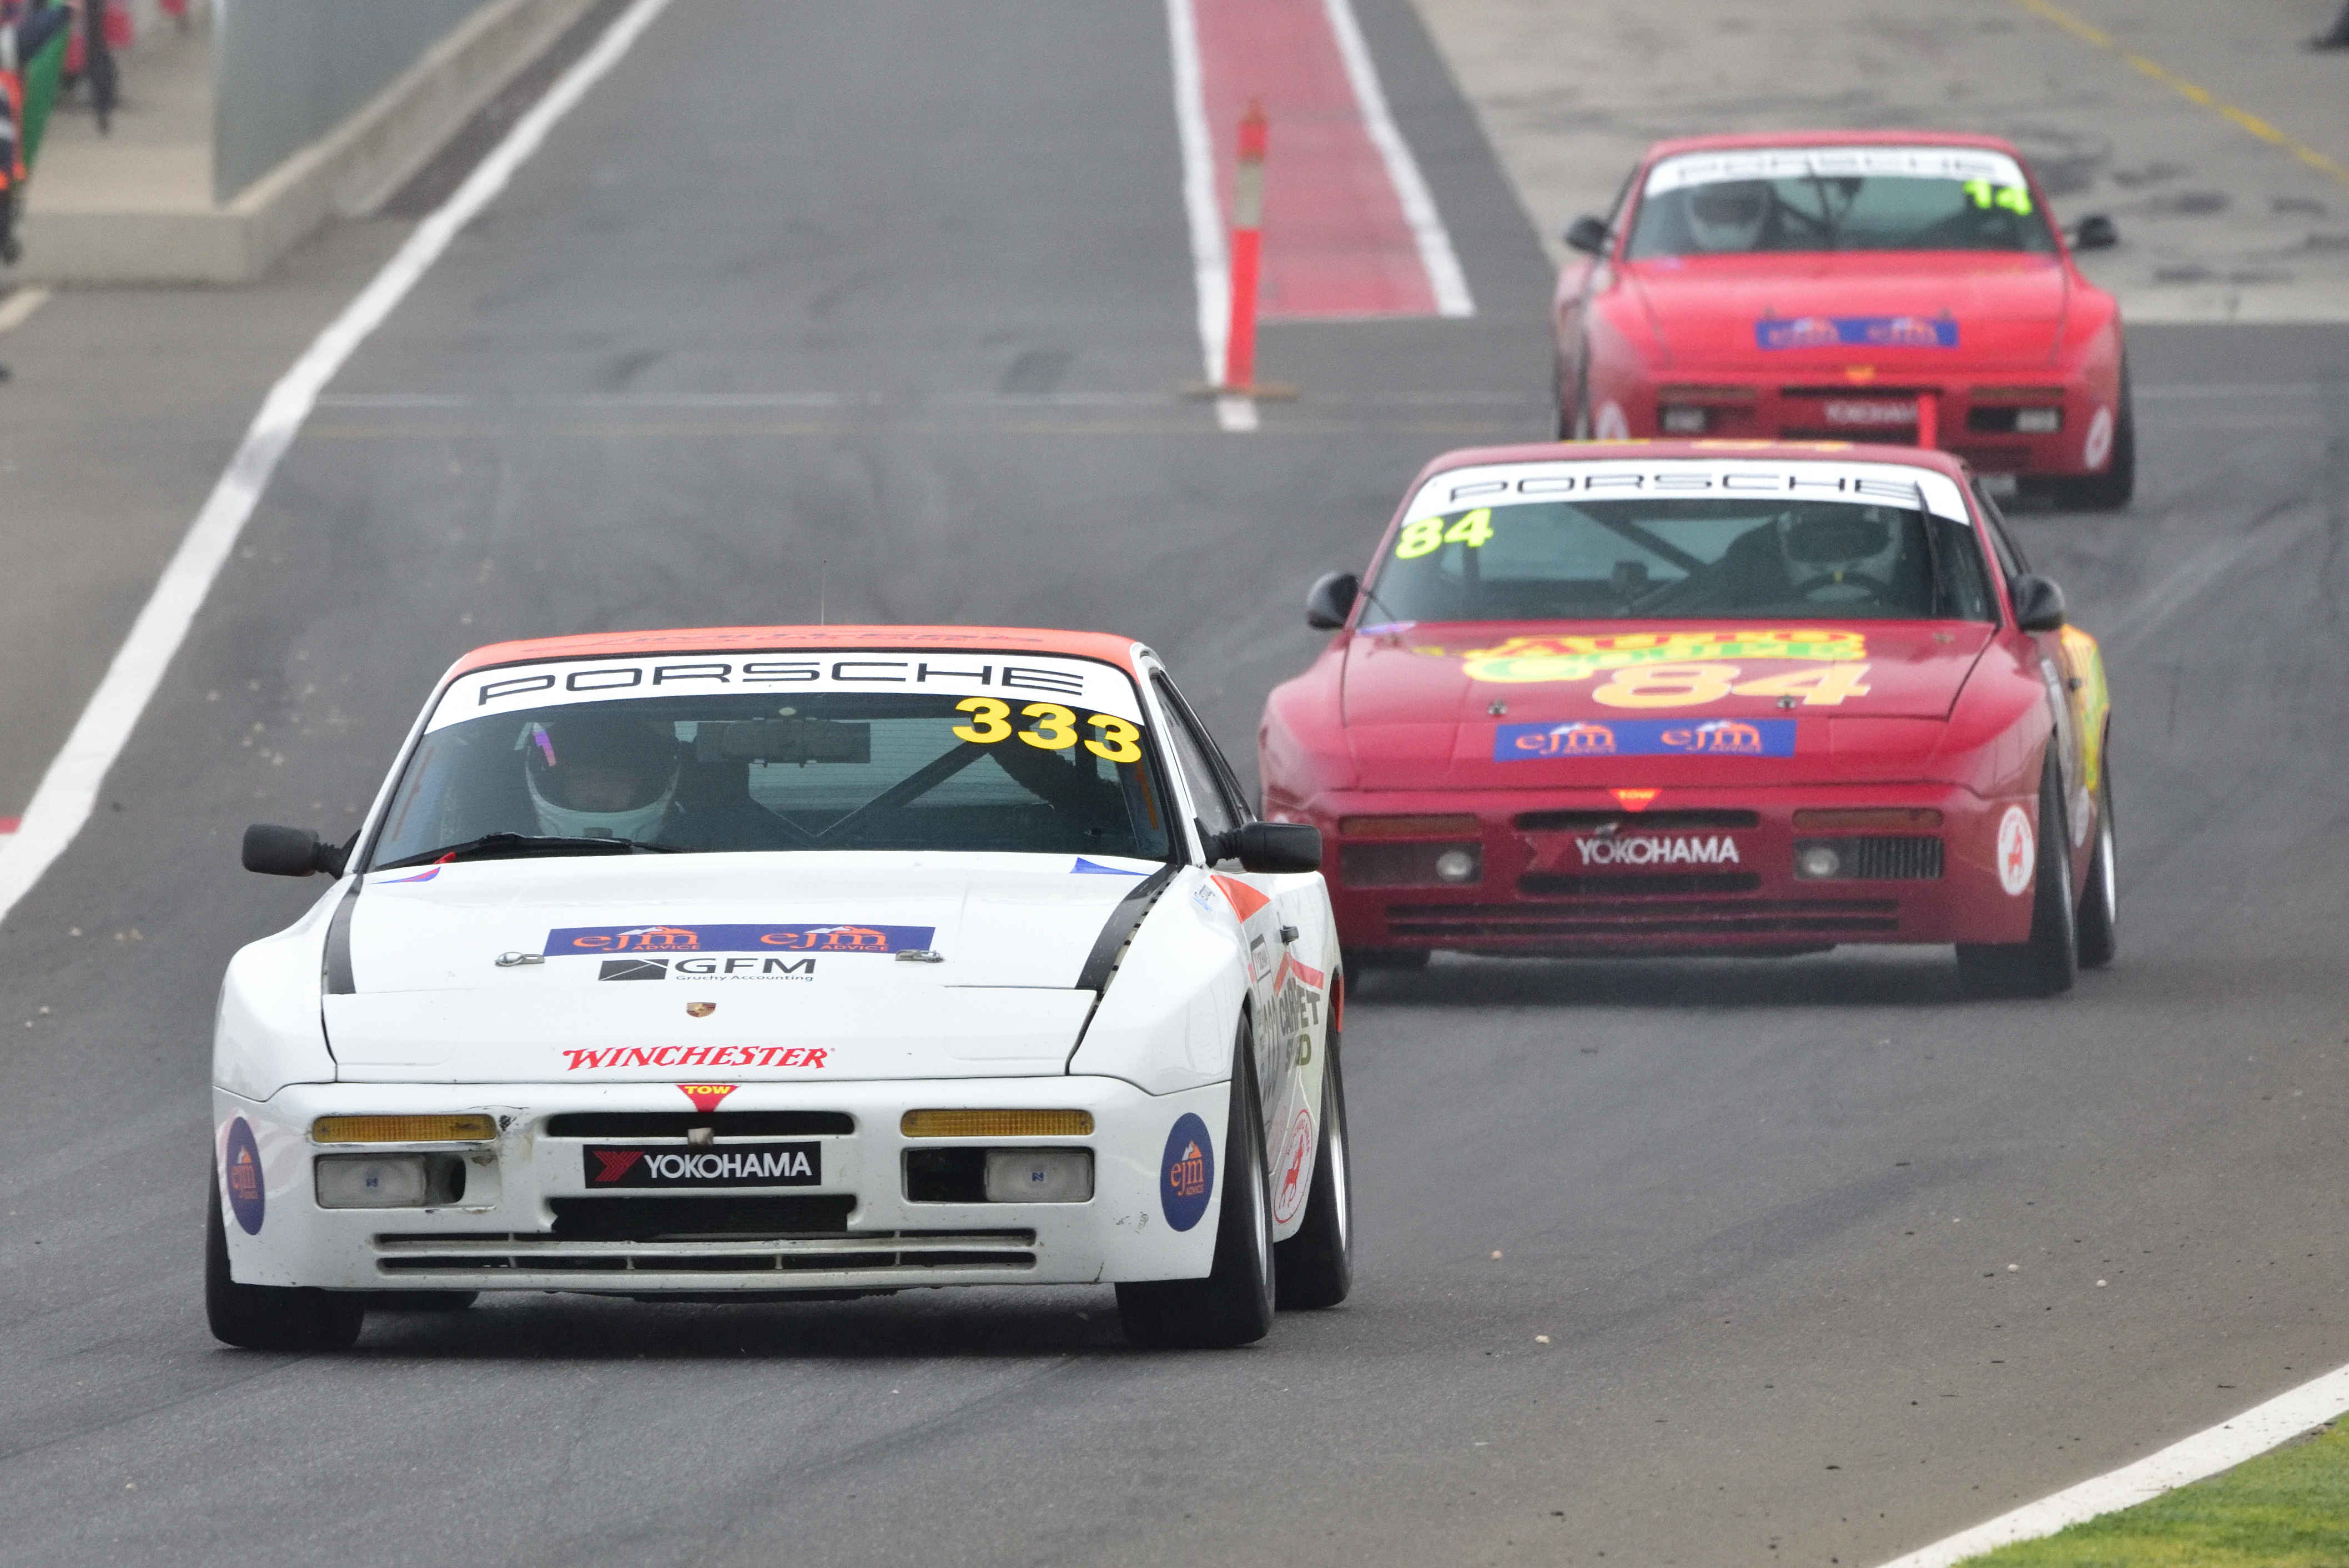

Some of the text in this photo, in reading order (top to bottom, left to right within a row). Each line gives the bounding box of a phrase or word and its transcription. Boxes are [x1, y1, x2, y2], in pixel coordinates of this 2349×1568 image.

[1964, 179, 2030, 214] 14
[1449, 474, 1917, 503] PORSCHE
[1396, 507, 1494, 560] 84
[477, 661, 1084, 706] PORSCHE
[1593, 664, 1870, 708] 84
[952, 697, 1141, 763] 333
[1575, 835, 1740, 866] YOKOHAMA
[573, 932, 698, 951] ejm
[760, 931, 887, 949] ejm
[675, 958, 816, 973] GFM
[562, 1046, 828, 1071] WINCHESTER
[685, 1085, 731, 1094] TOW
[644, 1152, 812, 1178] YOKOHAMA
[1170, 1158, 1204, 1196] ejm
